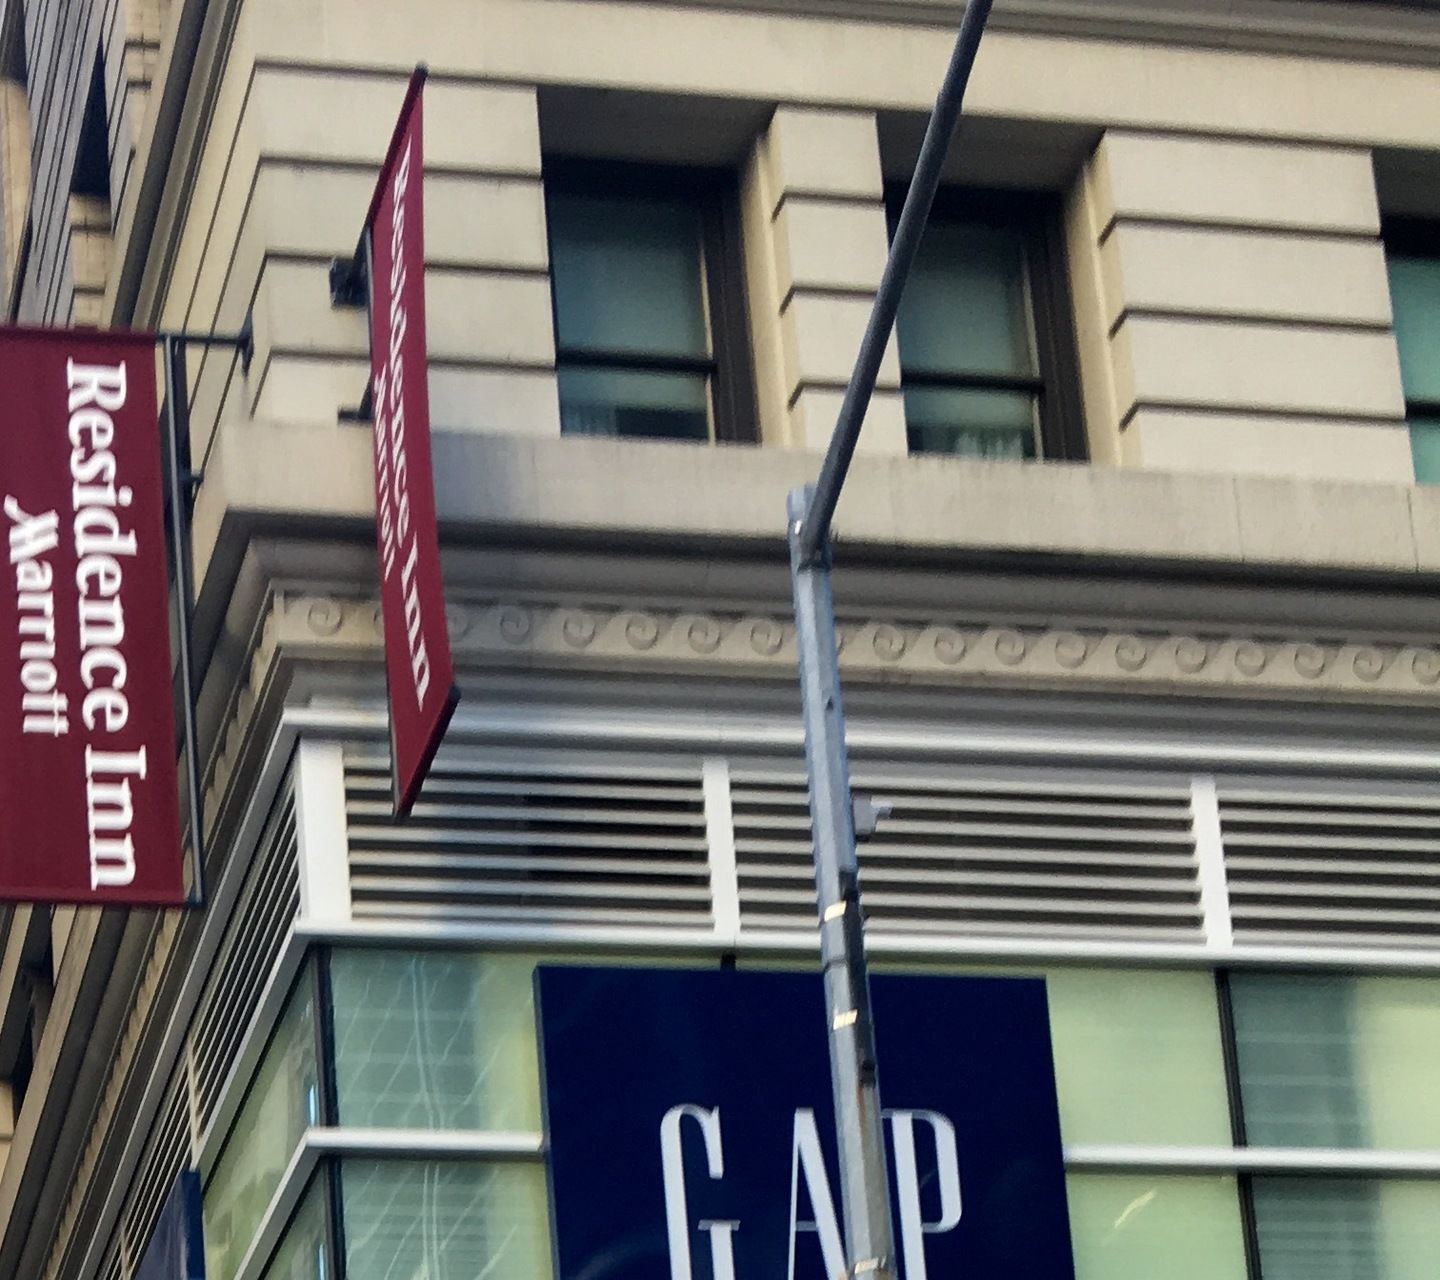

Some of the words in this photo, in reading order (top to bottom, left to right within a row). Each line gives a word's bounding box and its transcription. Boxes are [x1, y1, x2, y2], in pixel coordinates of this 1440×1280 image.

[66, 357, 138, 733] Residence
[389, 134, 412, 548] Residence
[401, 533, 432, 712] Inn
[3, 494, 70, 738] Marriott
[85, 745, 147, 891] Inn
